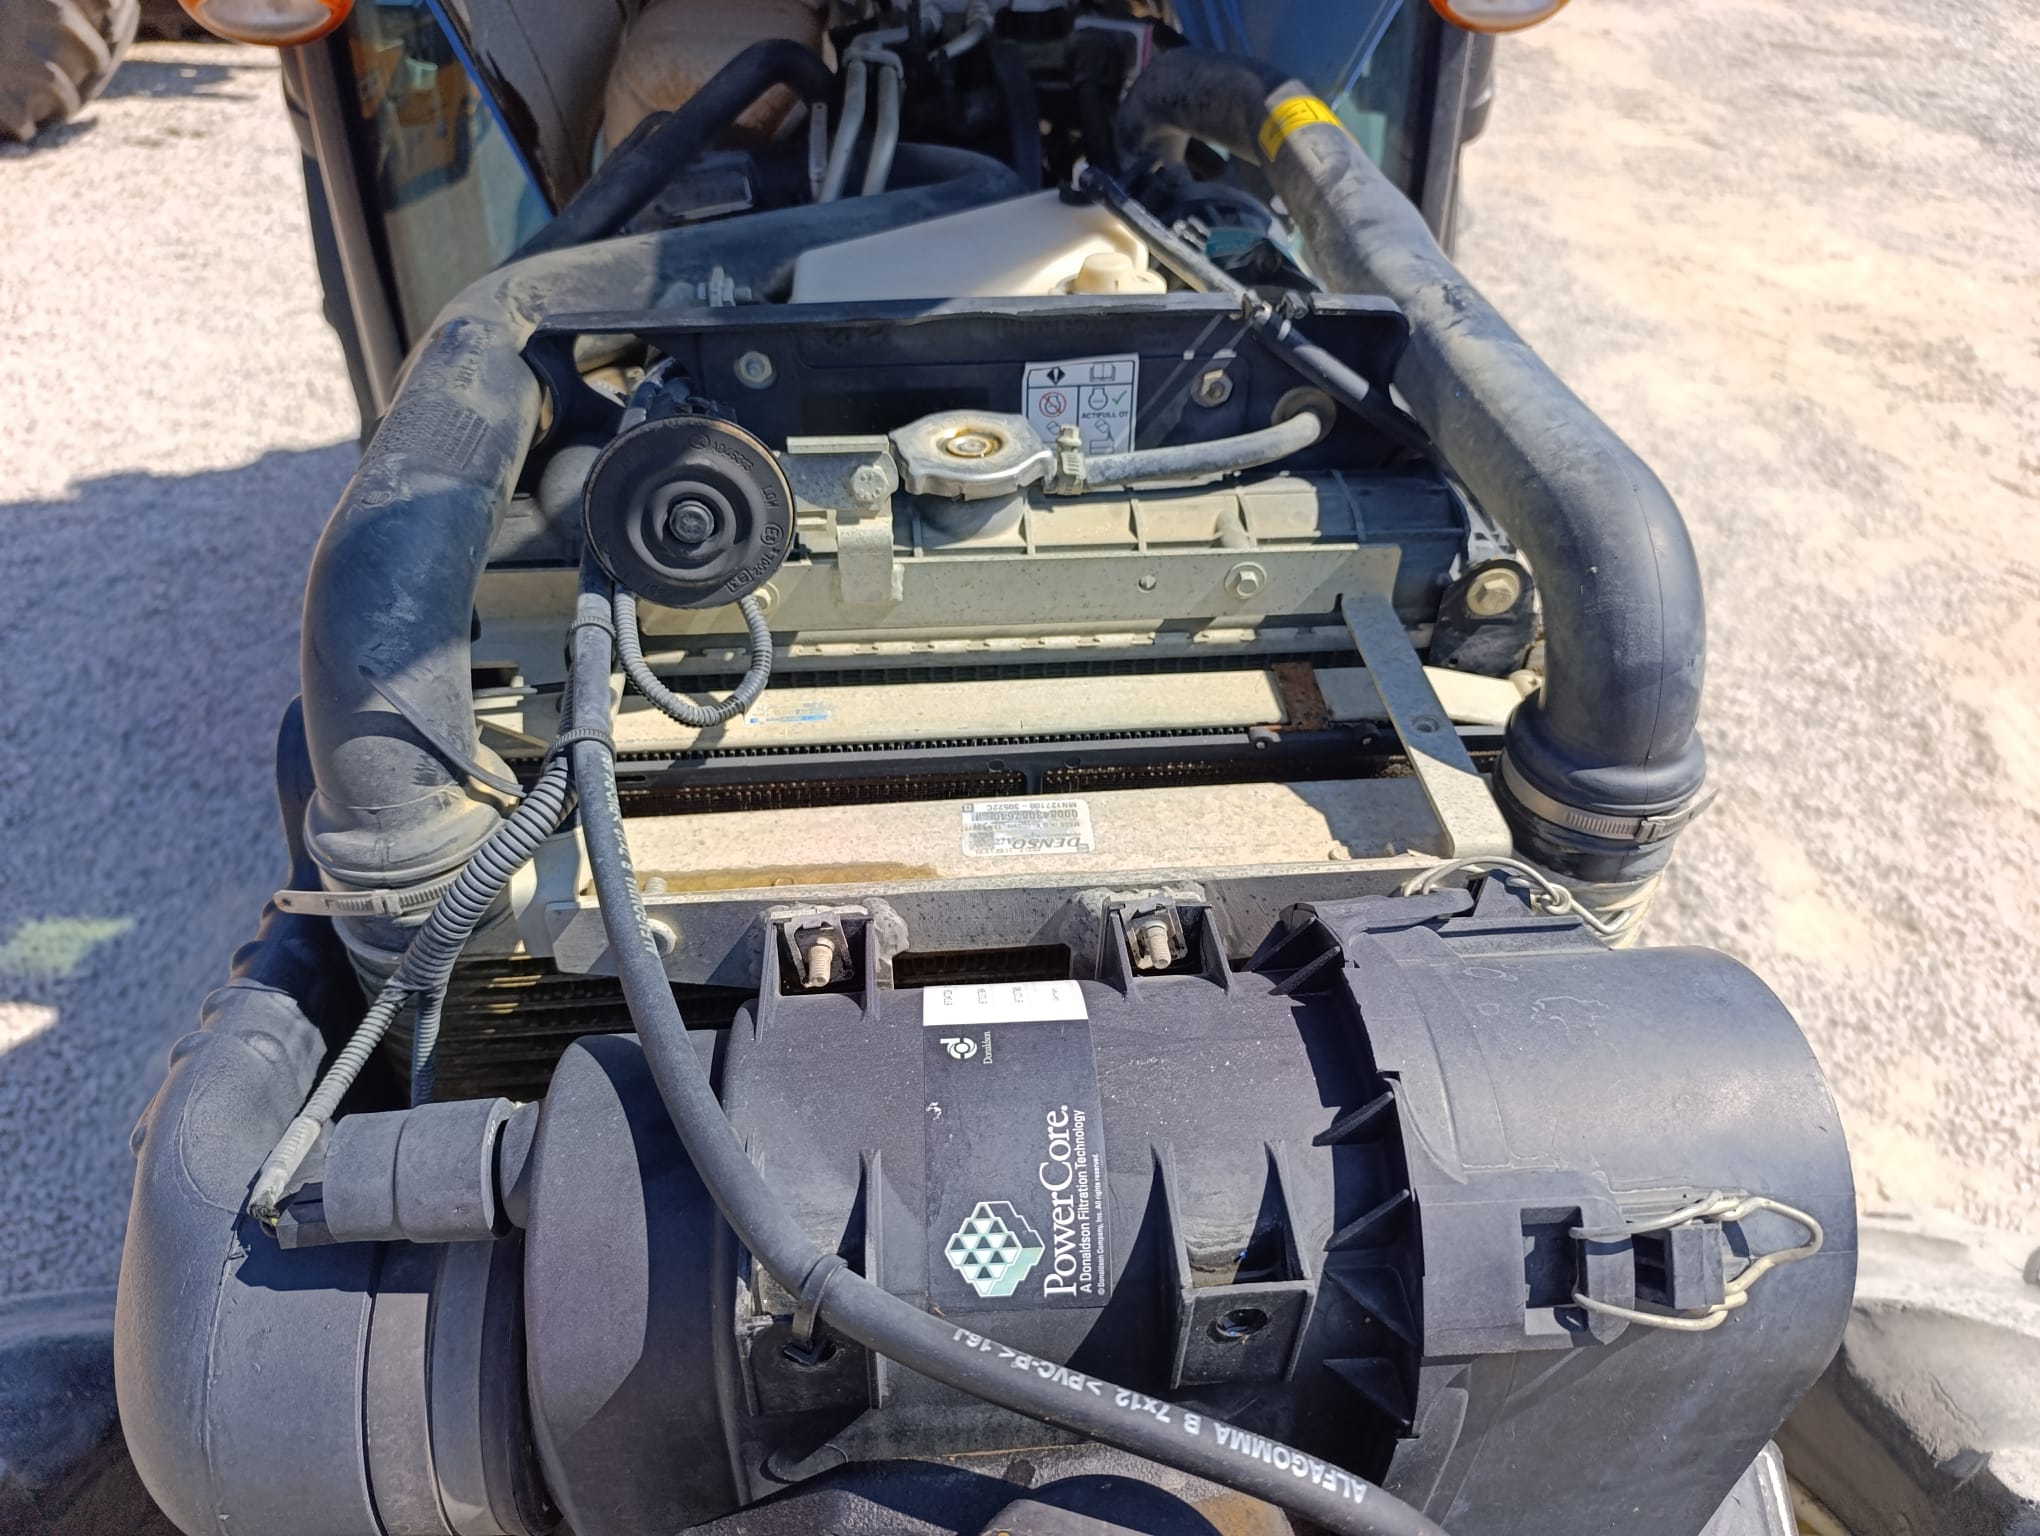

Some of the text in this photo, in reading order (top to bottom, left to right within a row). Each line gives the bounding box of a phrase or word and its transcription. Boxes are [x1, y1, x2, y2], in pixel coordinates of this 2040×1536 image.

[1081, 411, 1116, 419] ACTIFULL
[1012, 837, 1081, 849] DENSO
[983, 1030, 992, 1065] Donaldson
[1072, 1109, 1093, 1293] A Donaldson Filtration Technology
[1094, 1182, 1102, 1197] rights
[1115, 1386, 1171, 1423] 7x12
[1184, 1412, 1201, 1435] B
[1213, 1422, 1367, 1504] ALFAGOMMA
